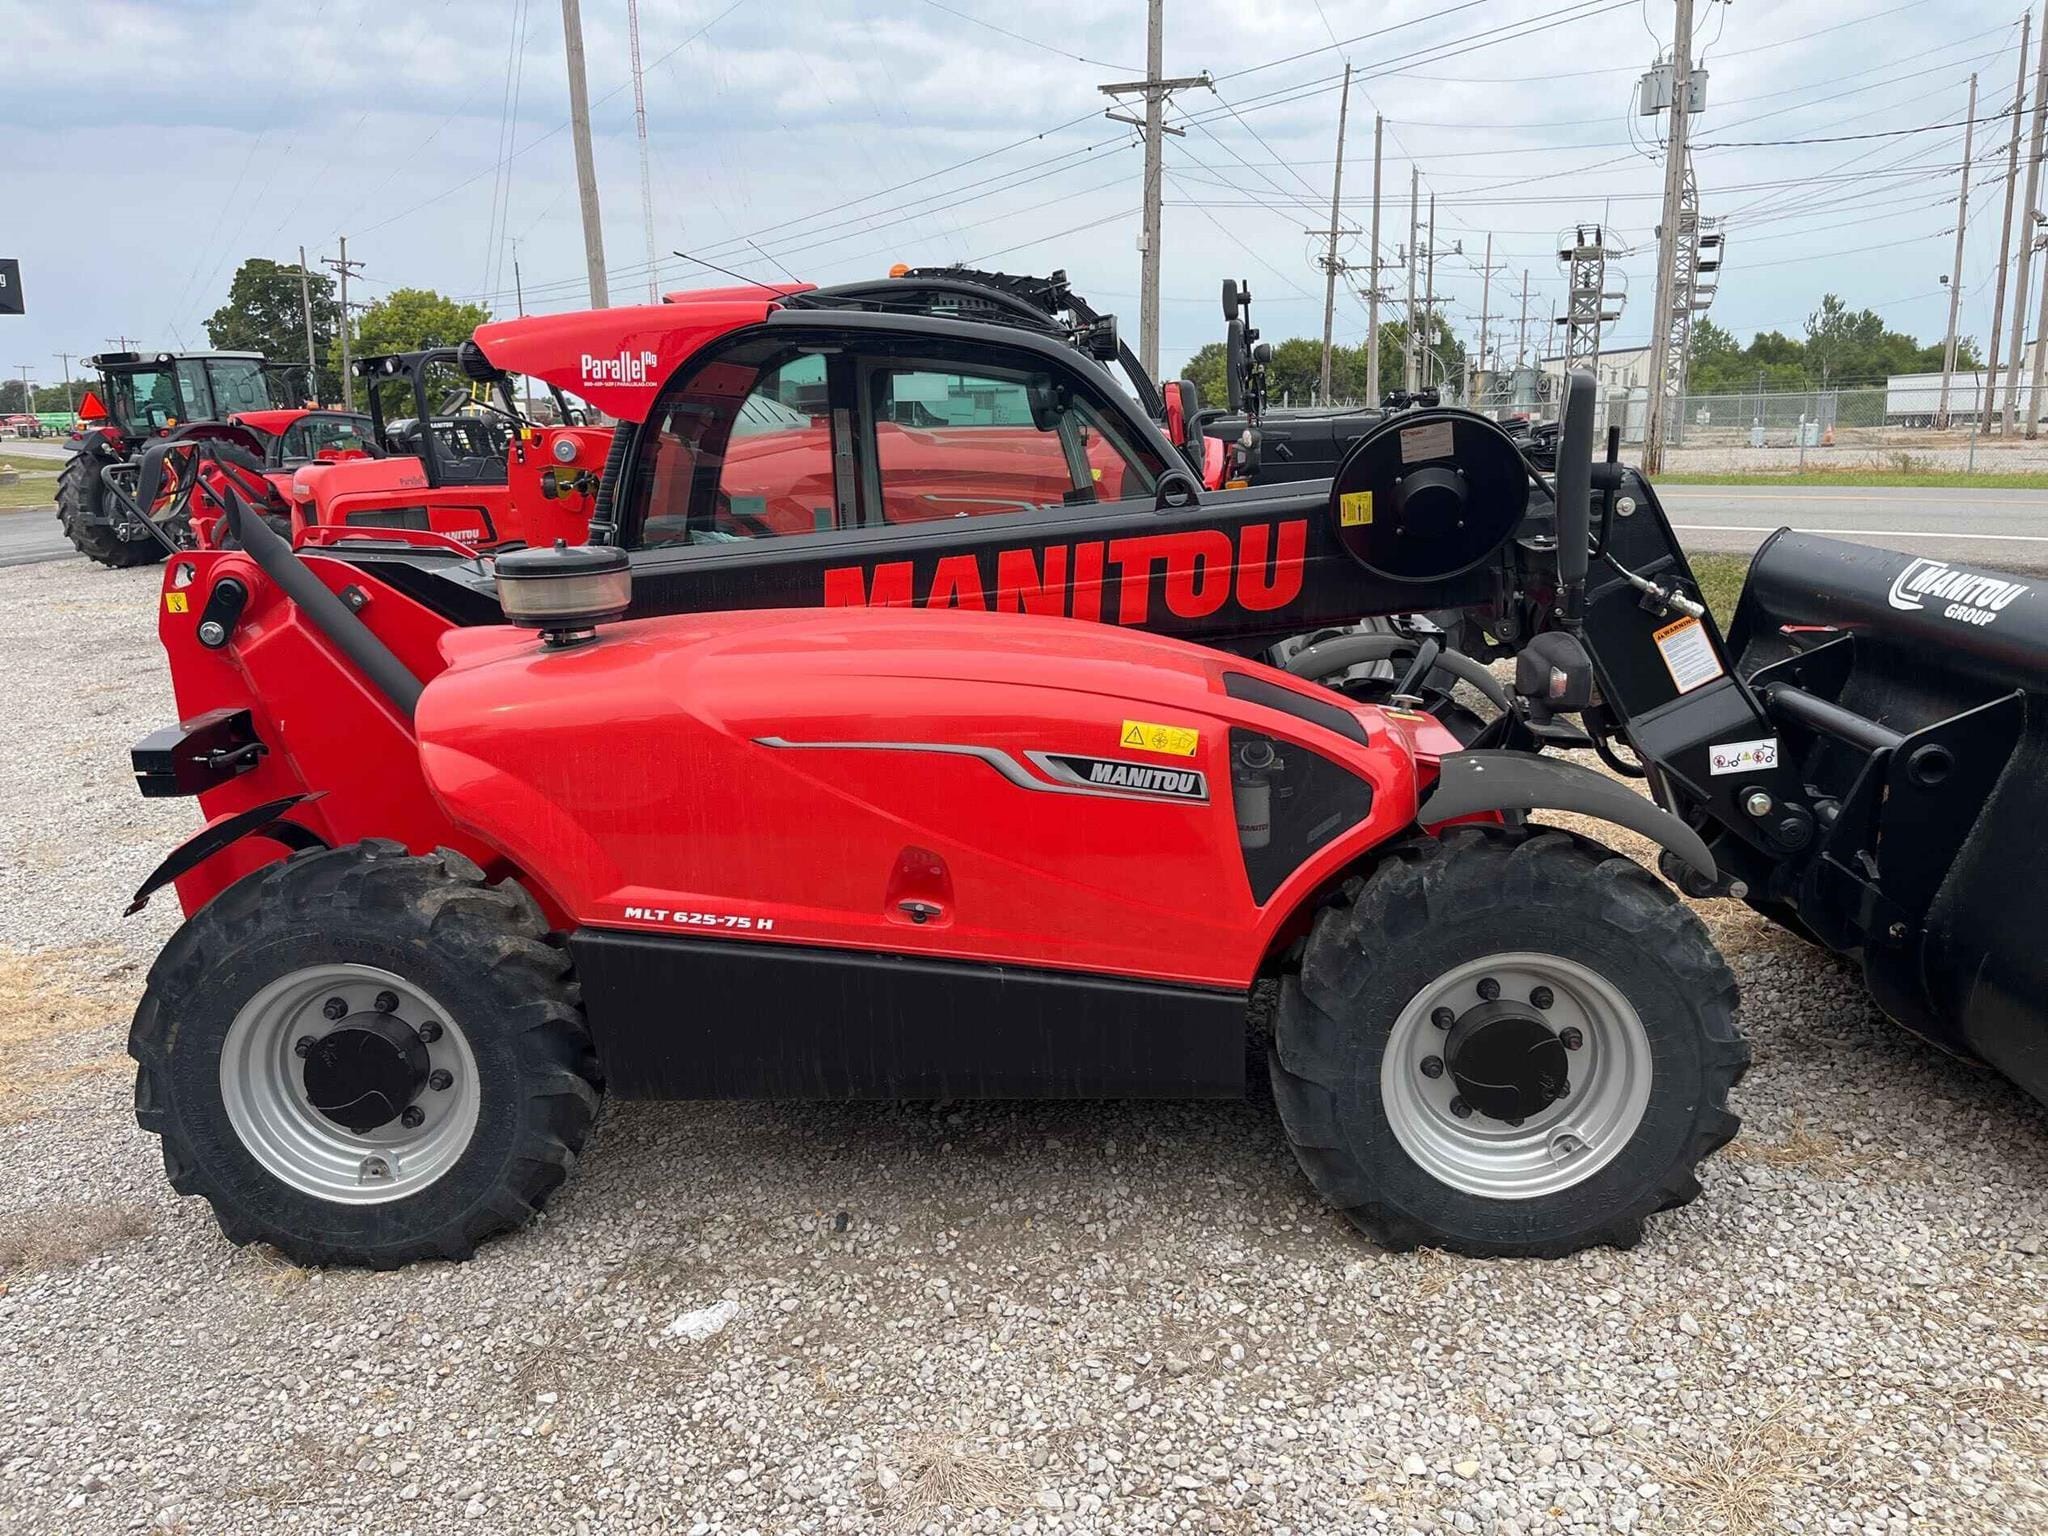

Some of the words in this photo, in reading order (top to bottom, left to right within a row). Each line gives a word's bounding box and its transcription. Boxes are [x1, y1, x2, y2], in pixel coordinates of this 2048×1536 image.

[1905, 566, 2030, 611] MANITOU
[1943, 603, 1997, 627] GROUP
[1090, 762, 1195, 793] MANITOU
[624, 907, 669, 921] MLT
[673, 911, 751, 929] 625-75
[756, 918, 773, 930] H
